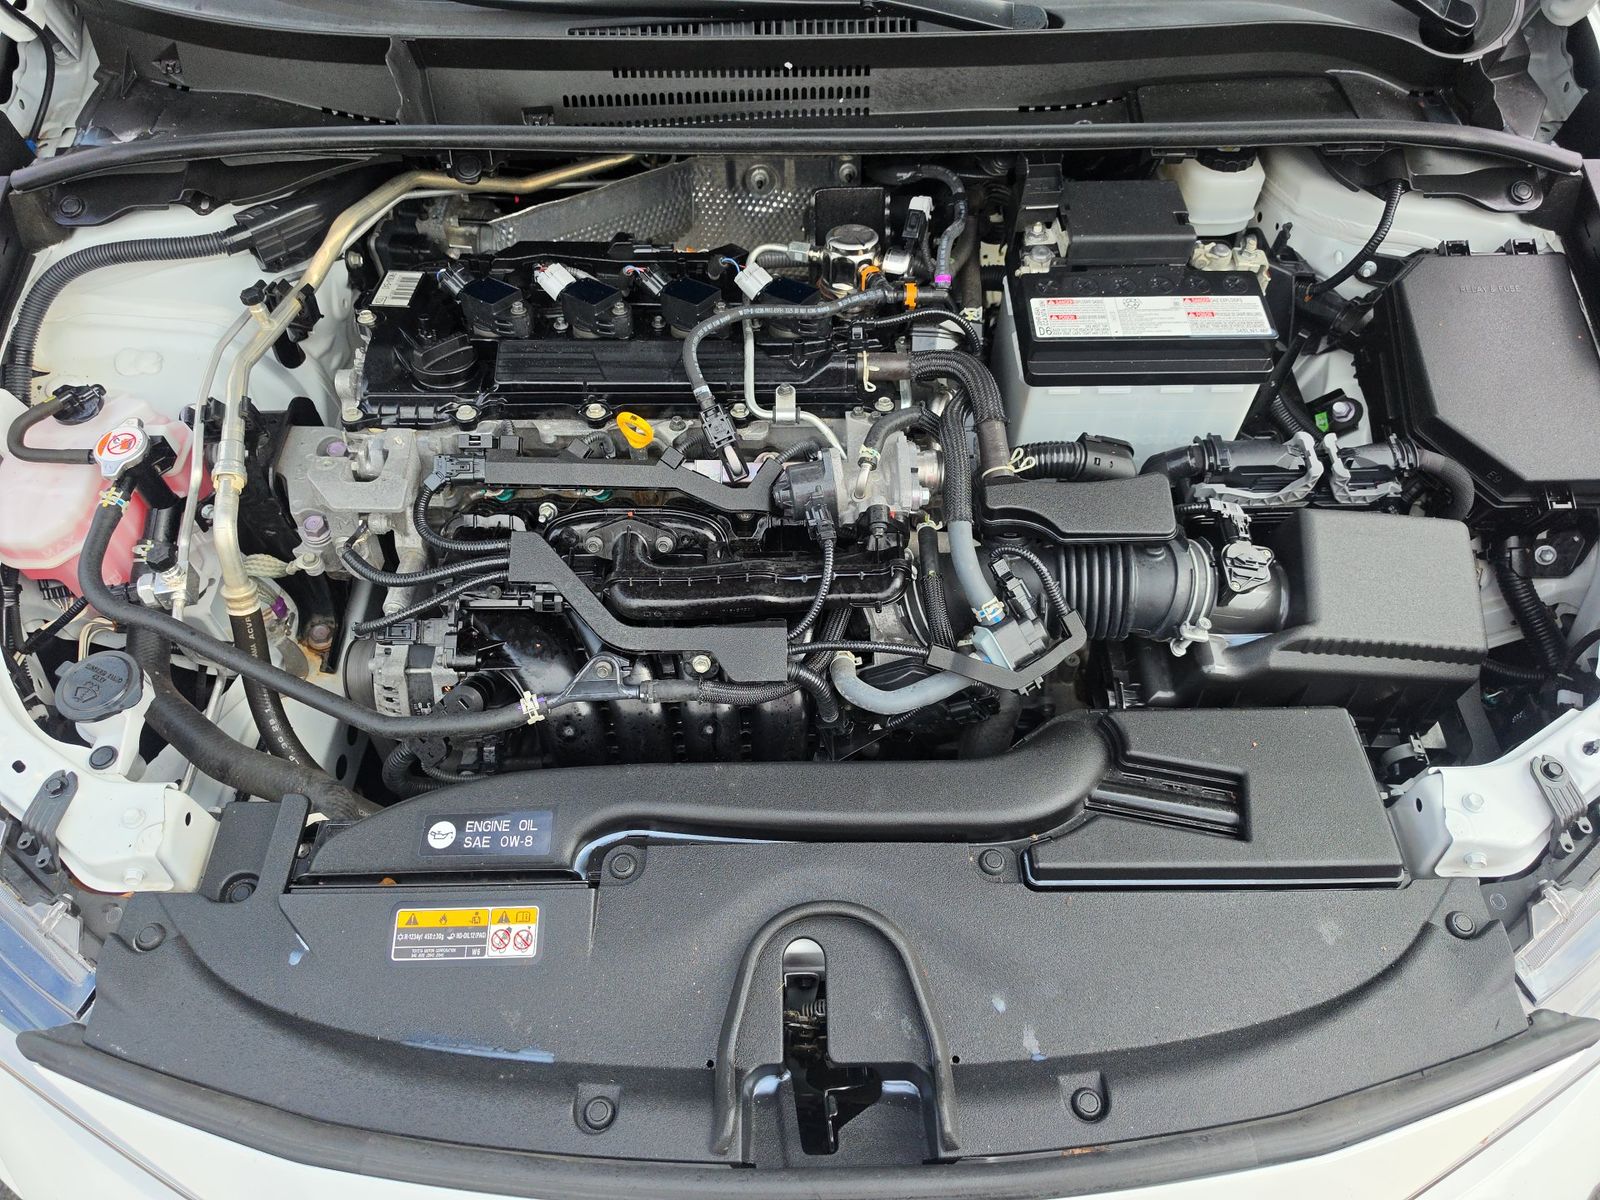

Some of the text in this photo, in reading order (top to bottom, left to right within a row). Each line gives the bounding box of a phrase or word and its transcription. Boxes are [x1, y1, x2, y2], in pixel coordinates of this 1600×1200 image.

[1497, 284, 1521, 292] FUSE
[1039, 327, 1052, 336] D6
[465, 819, 538, 833] ENGINE OIL
[463, 835, 533, 848] SAE 0W-8
